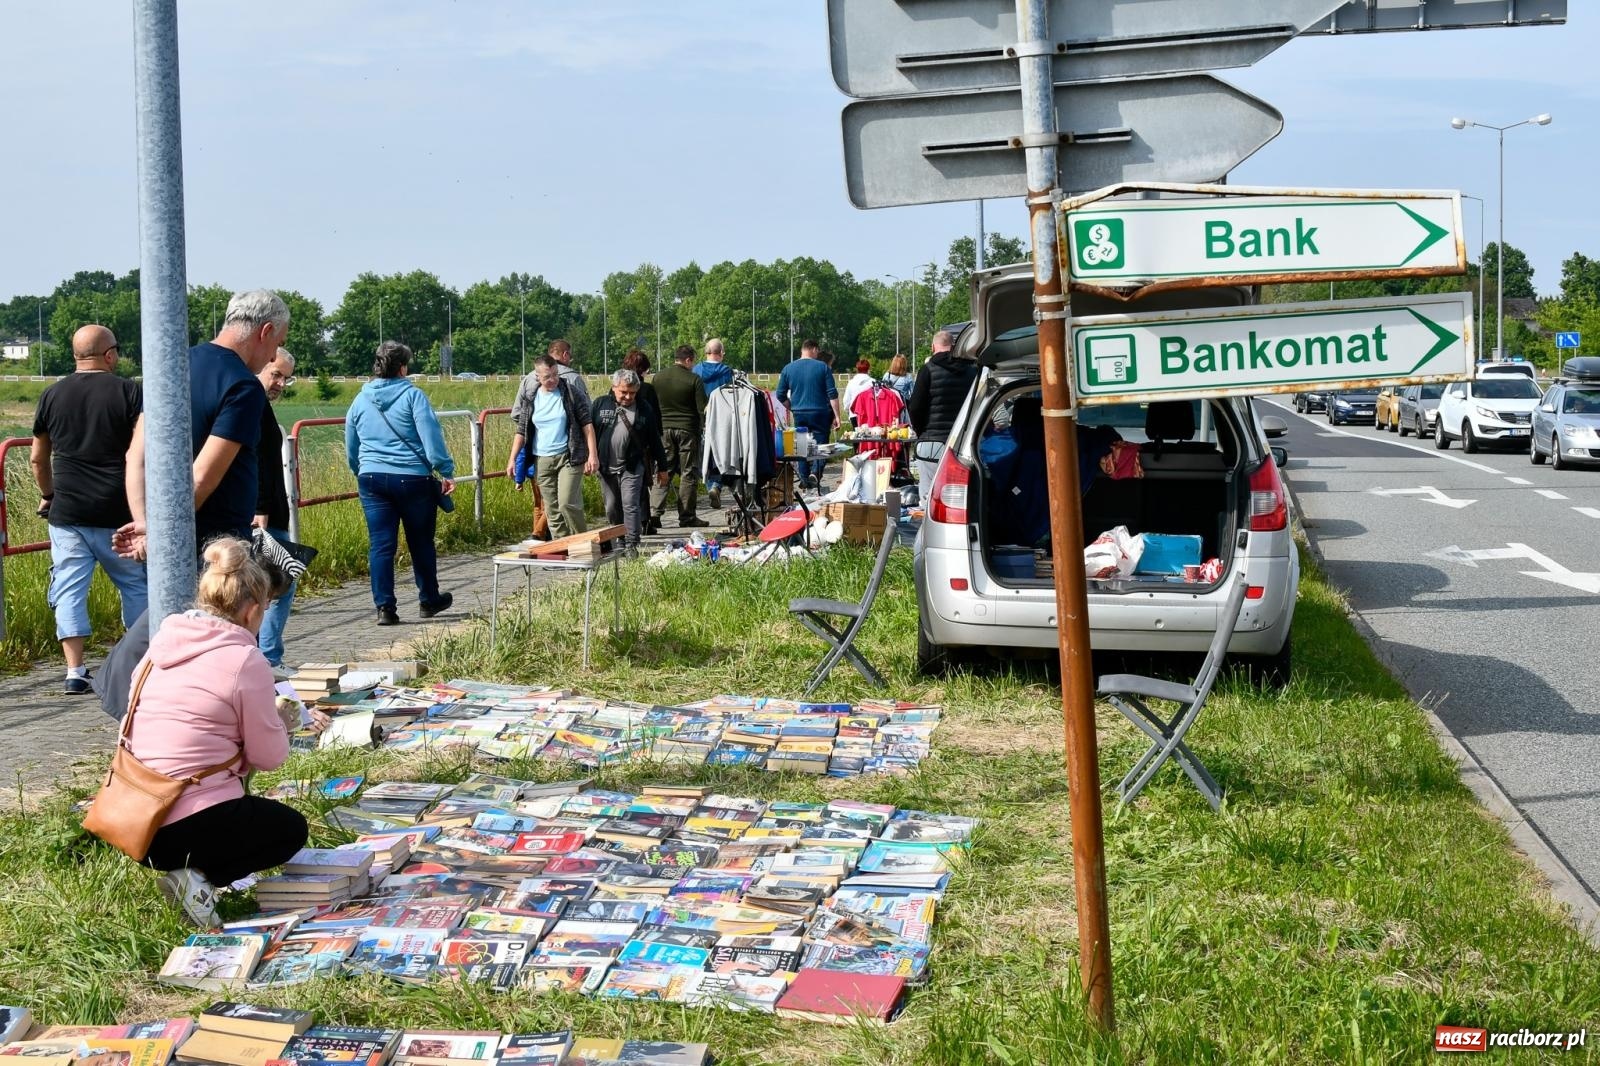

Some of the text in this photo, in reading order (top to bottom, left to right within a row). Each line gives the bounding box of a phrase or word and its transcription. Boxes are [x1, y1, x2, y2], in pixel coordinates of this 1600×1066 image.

[1205, 218, 1320, 259] Bank
[1114, 361, 1123, 378] 100
[1160, 324, 1389, 375] Bankomat
